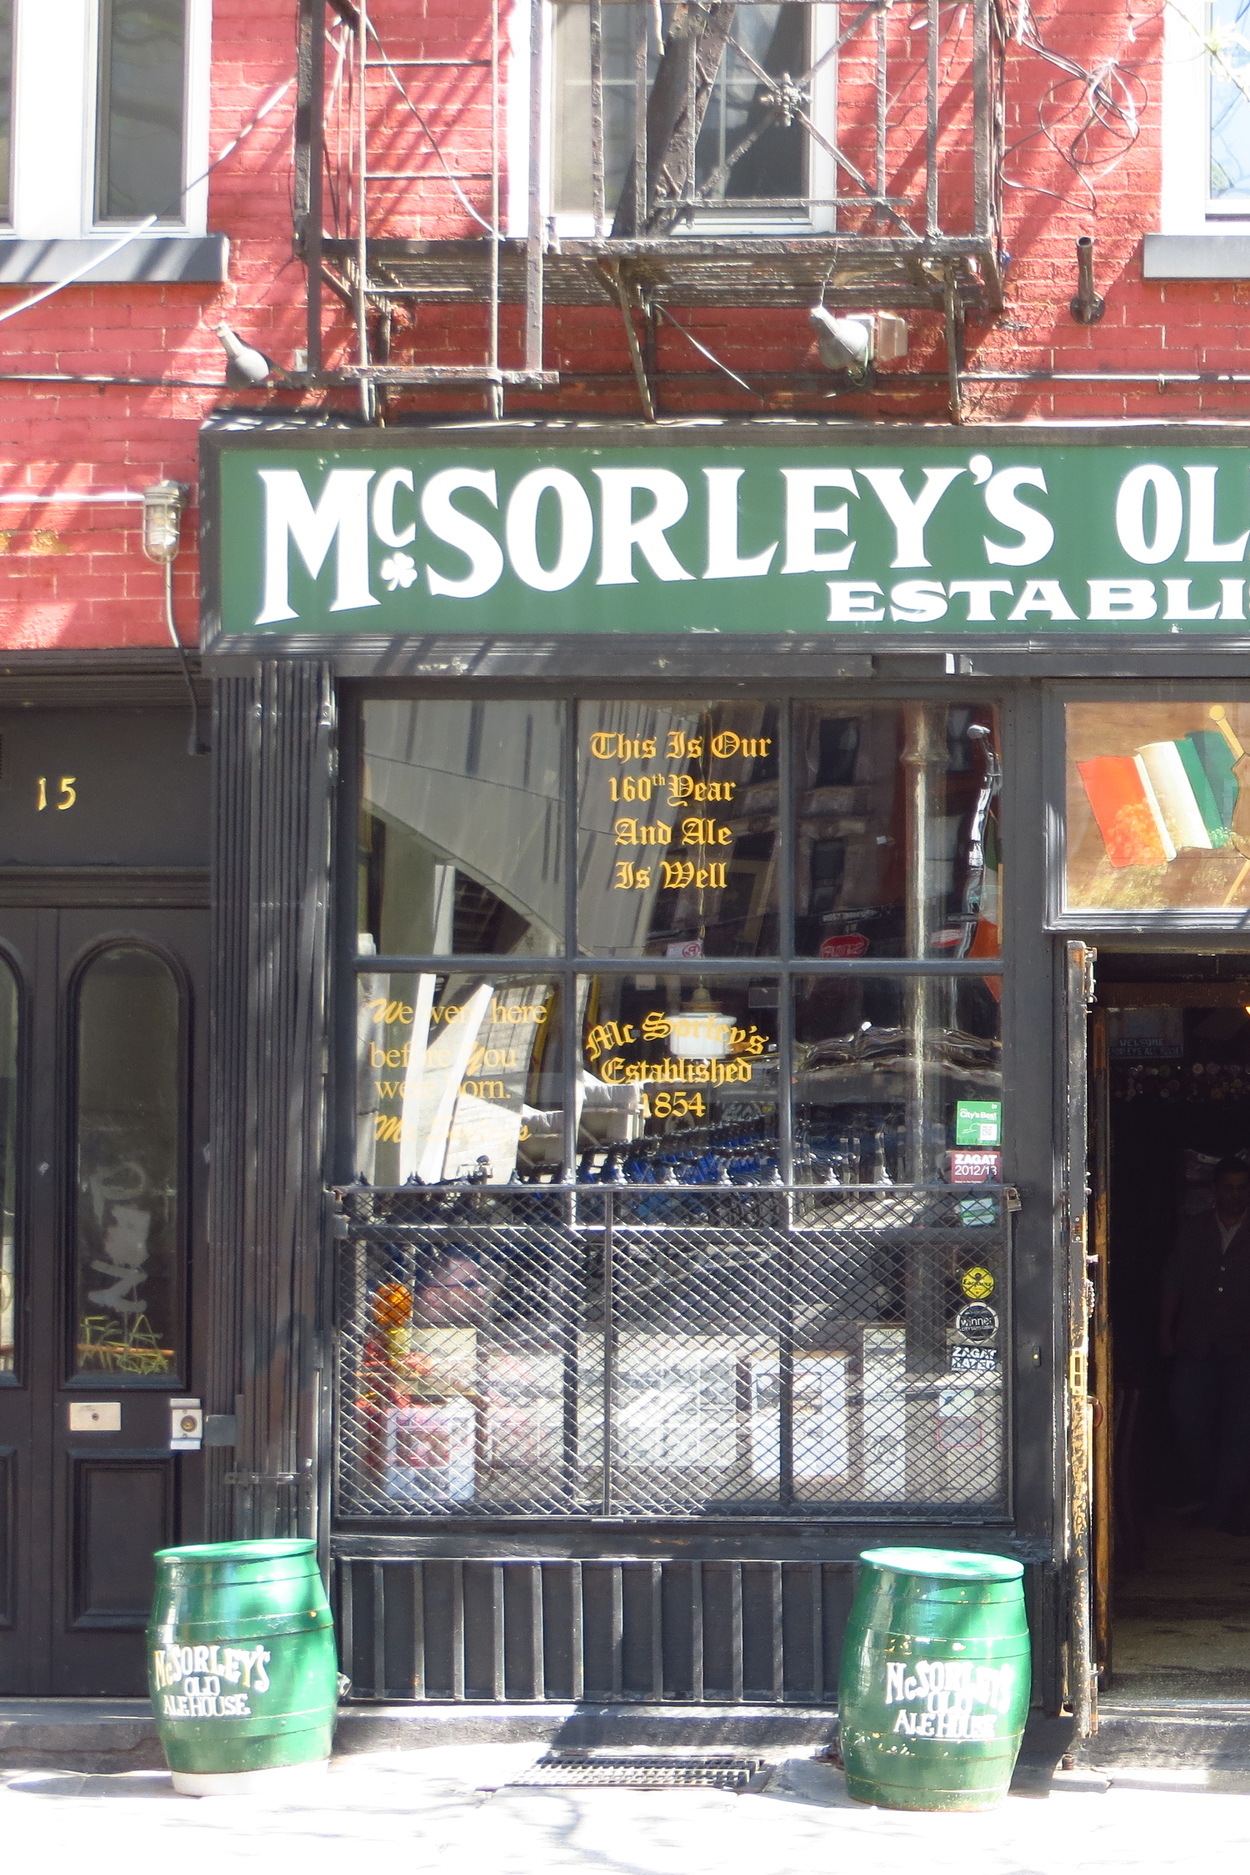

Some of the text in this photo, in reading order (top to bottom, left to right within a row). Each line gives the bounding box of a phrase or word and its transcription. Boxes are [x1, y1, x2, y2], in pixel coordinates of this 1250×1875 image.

[589, 730, 773, 765] This Is Our
[37, 776, 77, 811] 15
[608, 772, 737, 807] 160th Year
[614, 816, 734, 846] And Ale
[613, 860, 729, 890] Is Well
[368, 998, 414, 1025] We
[490, 998, 548, 1025] here
[585, 1011, 771, 1062] Mc Sorley's
[600, 1057, 753, 1090] Established
[639, 1091, 708, 1119] 1854
[960, 1110, 998, 1120] City's Best
[954, 1153, 998, 1165] ZAGAT
[954, 1165, 998, 1176] 2012/13
[184, 1676, 221, 1698] OLD
[926, 1690, 973, 1715] OLD
